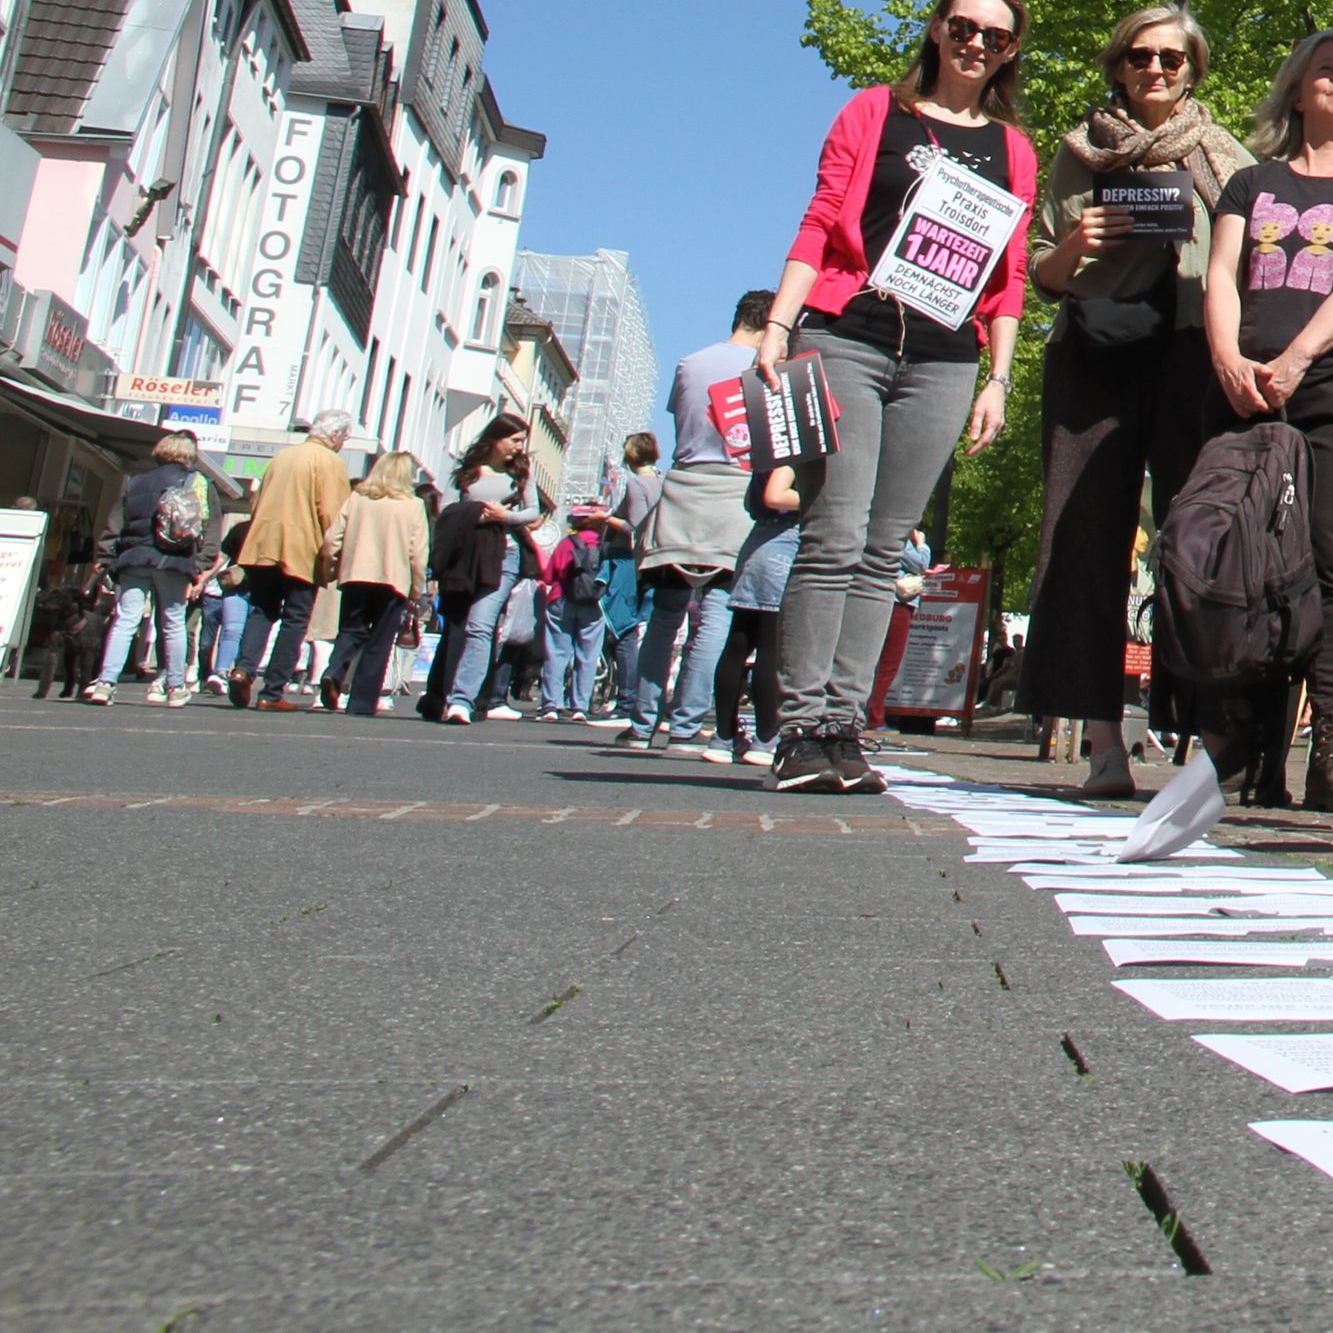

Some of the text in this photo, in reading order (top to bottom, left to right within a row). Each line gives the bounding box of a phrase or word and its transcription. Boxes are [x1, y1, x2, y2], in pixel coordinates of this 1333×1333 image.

[952, 191, 989, 220] Praxis
[1102, 187, 1180, 202] DEPRESSIV?
[938, 200, 991, 237] Troisdorf
[914, 218, 989, 263] WARTEZEIT
[232, 117, 312, 414] FOTOGRAF
[894, 263, 964, 301] DEMNÄCHST
[886, 274, 960, 315] NOCH LÄNGER
[130, 377, 213, 397] Röseler
[280, 401, 291, 416] 7
